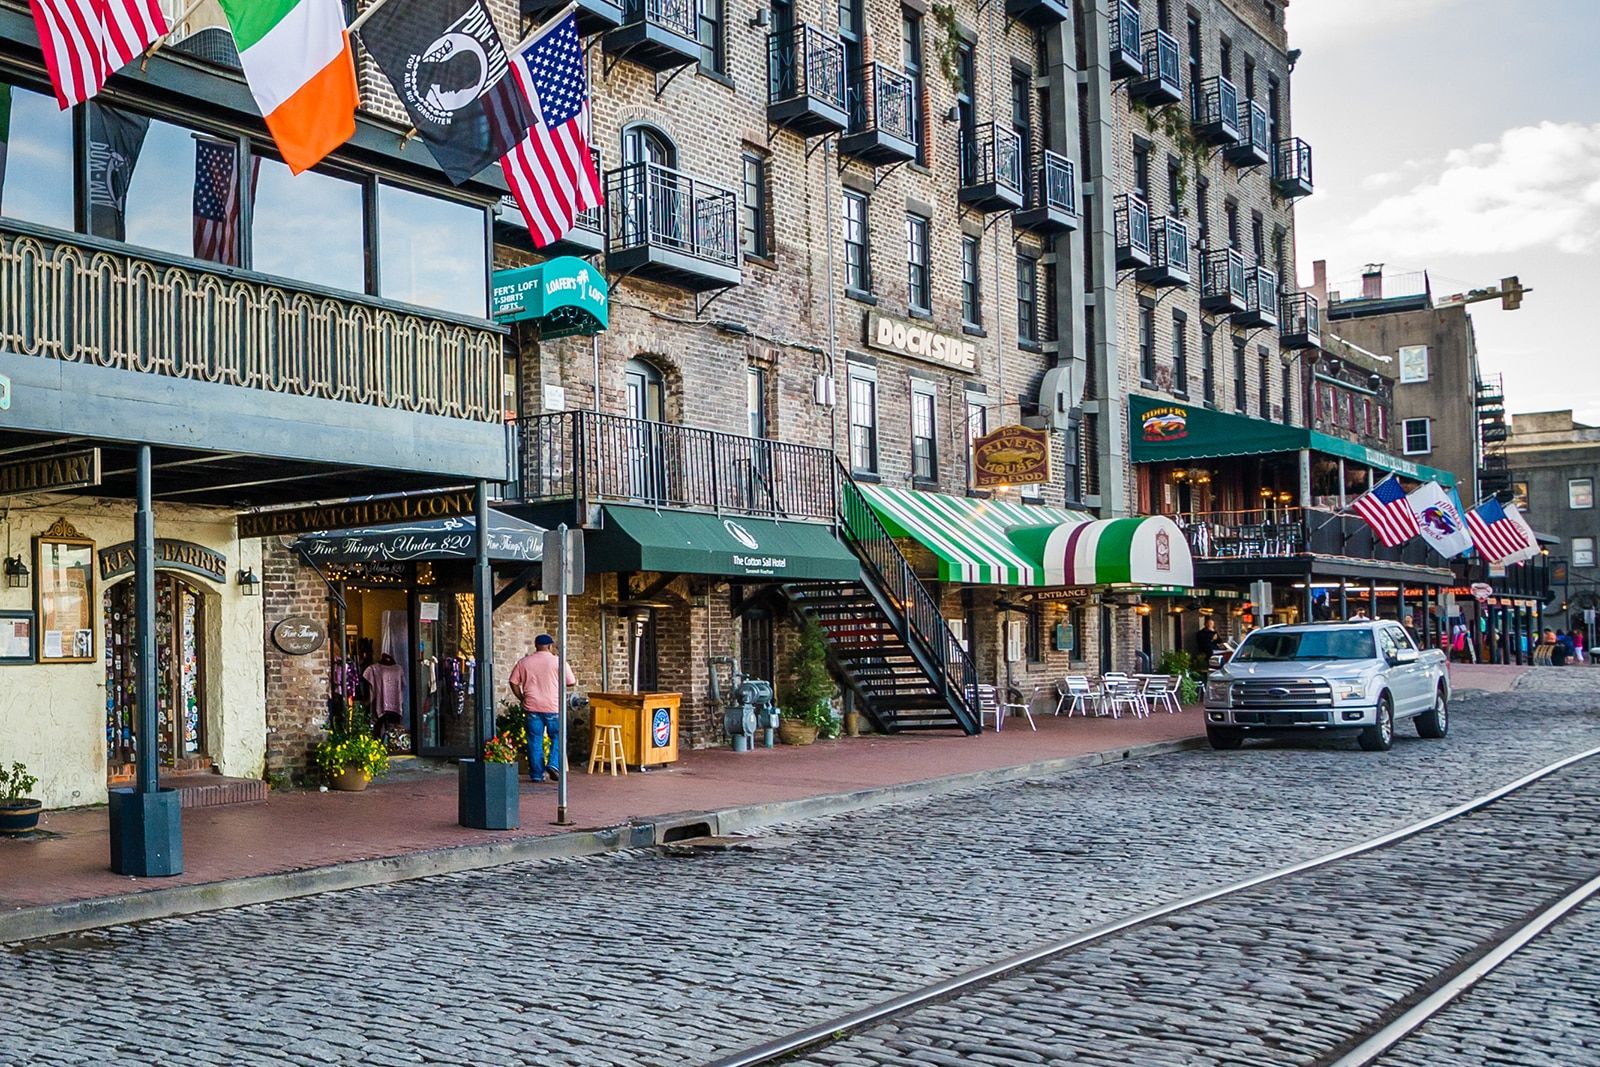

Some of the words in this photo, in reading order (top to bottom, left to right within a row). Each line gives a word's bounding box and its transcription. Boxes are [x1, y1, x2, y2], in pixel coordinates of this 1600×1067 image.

[406, 54, 416, 69] YOU
[414, 103, 452, 125] FORGOTTEN
[517, 280, 538, 292] LOFT
[493, 292, 524, 305] T-SHIRTS
[588, 285, 606, 306] LOFT
[877, 317, 975, 369] DOCKSIDE
[981, 438, 1038, 455] RIVER
[983, 459, 1037, 474] HOUSE
[980, 472, 1044, 485] SEAFOOD
[238, 513, 298, 537] RIVER
[302, 505, 369, 529] WATCH
[373, 492, 476, 522] BALCONY
[307, 539, 339, 556] Fine
[341, 538, 381, 560] Things
[392, 535, 437, 552] Under
[440, 533, 471, 550] $20
[733, 555, 744, 565] The
[744, 556, 762, 566] Cotton
[762, 557, 772, 567] Sail
[772, 557, 786, 568] Hotel
[1037, 588, 1088, 600] ENTRANCE
